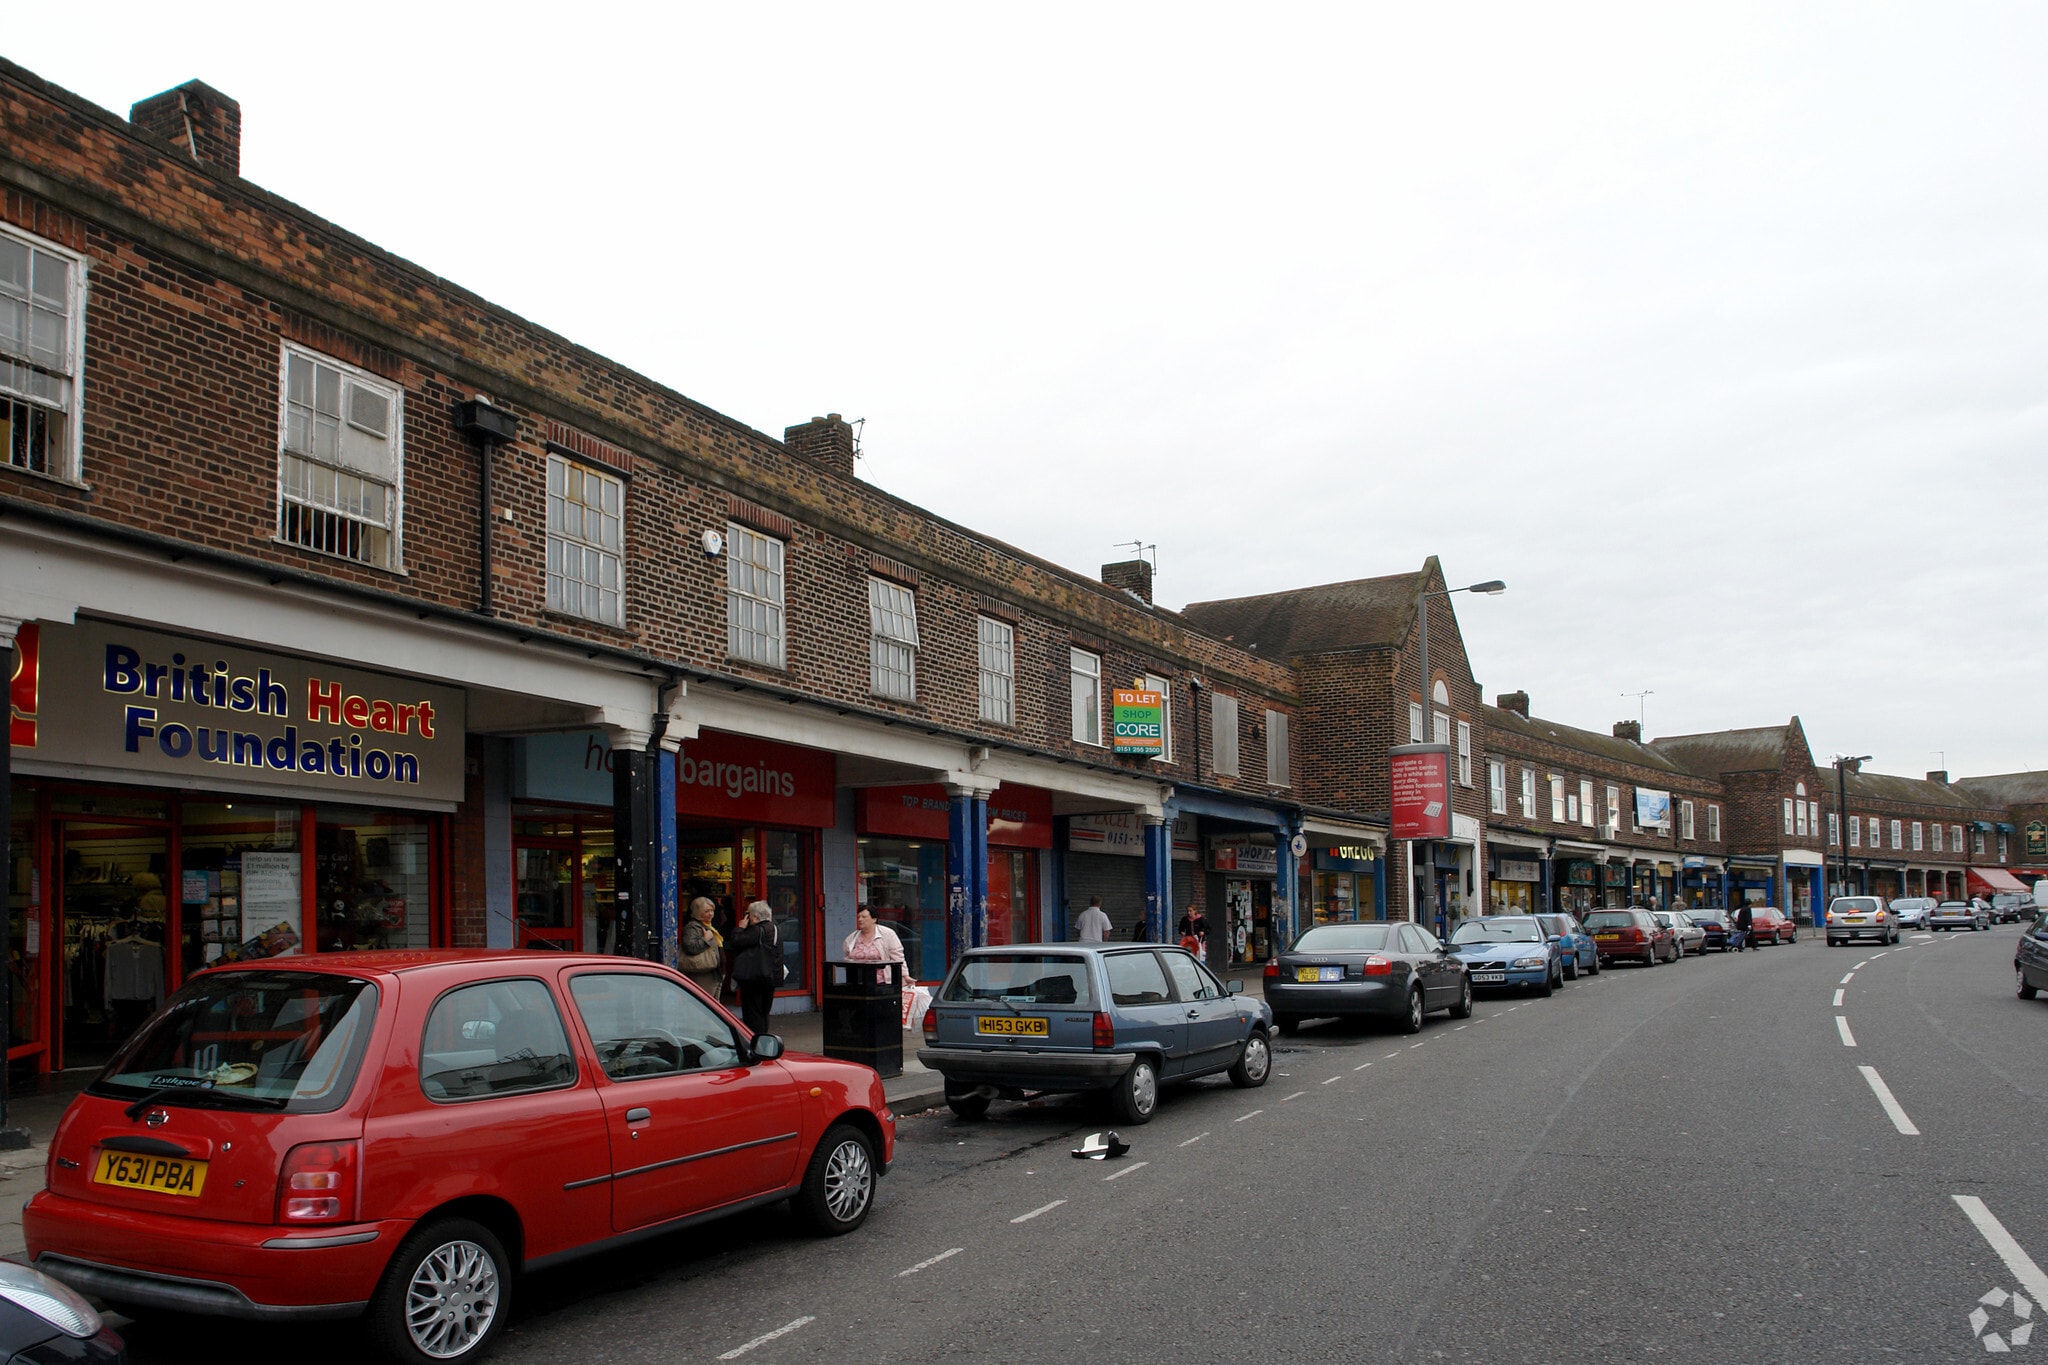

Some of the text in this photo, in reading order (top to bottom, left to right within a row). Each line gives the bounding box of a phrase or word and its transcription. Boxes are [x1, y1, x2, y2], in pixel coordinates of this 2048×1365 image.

[103, 644, 435, 739] British Heart
[1119, 693, 1156, 704] TO LET
[1123, 710, 1152, 719] SHOP
[1116, 723, 1159, 737] CORE
[124, 705, 421, 784] Foundation
[679, 747, 795, 798] bargains
[902, 795, 918, 808] TOP
[1001, 809, 1027, 822] PRICES
[1094, 814, 1130, 829] EXCEL
[1107, 831, 1128, 846] 0151
[246, 855, 263, 863] Help
[1238, 847, 1262, 860] SHOP
[281, 863, 290, 871] by
[983, 1019, 1043, 1032] H153 GKB
[153, 1076, 200, 1087] Lythgoe
[105, 1154, 150, 1184] Y631
[150, 1160, 195, 1191] PBA
